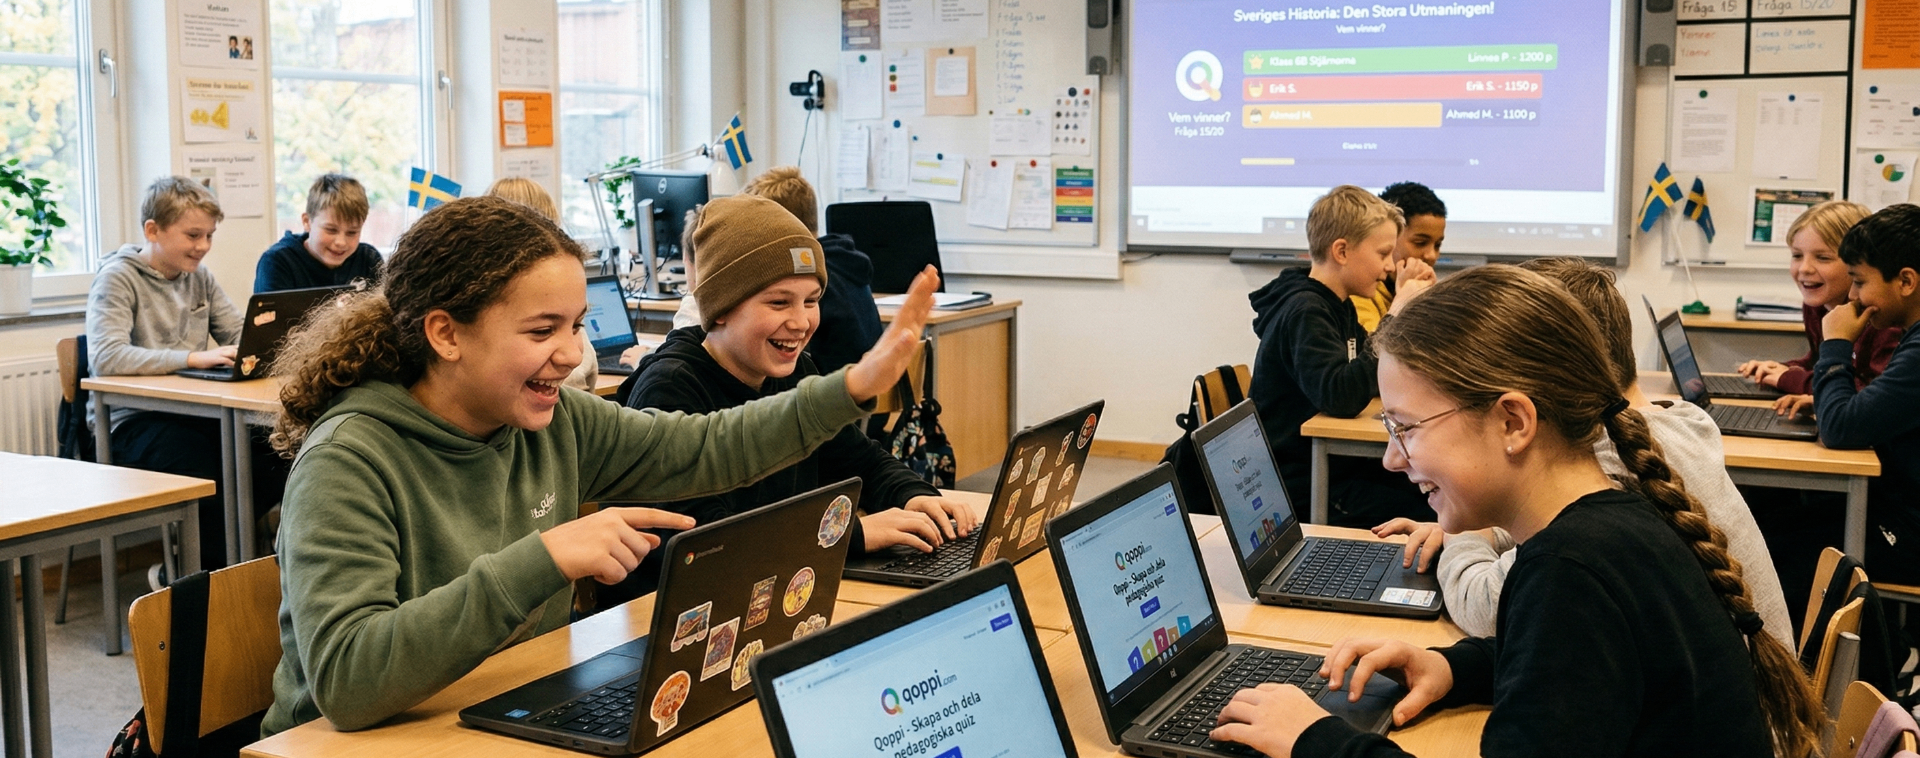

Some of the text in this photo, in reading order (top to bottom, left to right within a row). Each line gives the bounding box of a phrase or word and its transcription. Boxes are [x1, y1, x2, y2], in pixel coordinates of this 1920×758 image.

[1234, 1, 1495, 24] Sveriges Historia: Den Stora Utmaningen!
[1682, 1, 1715, 17] Fråga
[1336, 25, 1354, 34] Vem
[1519, 52, 1544, 62] 1200
[1545, 54, 1553, 63] p
[1269, 84, 1286, 93] Erik
[1466, 81, 1485, 91] Erik
[1505, 81, 1530, 91] 1150
[1530, 83, 1538, 92] p
[1168, 111, 1231, 123] Vem vinner?
[1446, 109, 1480, 119] Ahmed
[1482, 109, 1493, 119] M.
[1503, 109, 1528, 119] 1100
[1529, 111, 1536, 120] p
[1174, 126, 1224, 138] Fråga 15/20
[874, 725, 905, 752] Qoppi
[911, 711, 942, 733] Skapa
[942, 700, 961, 717] och
[961, 692, 981, 709] dela
[894, 713, 976, 758] pedagogiska quiz
